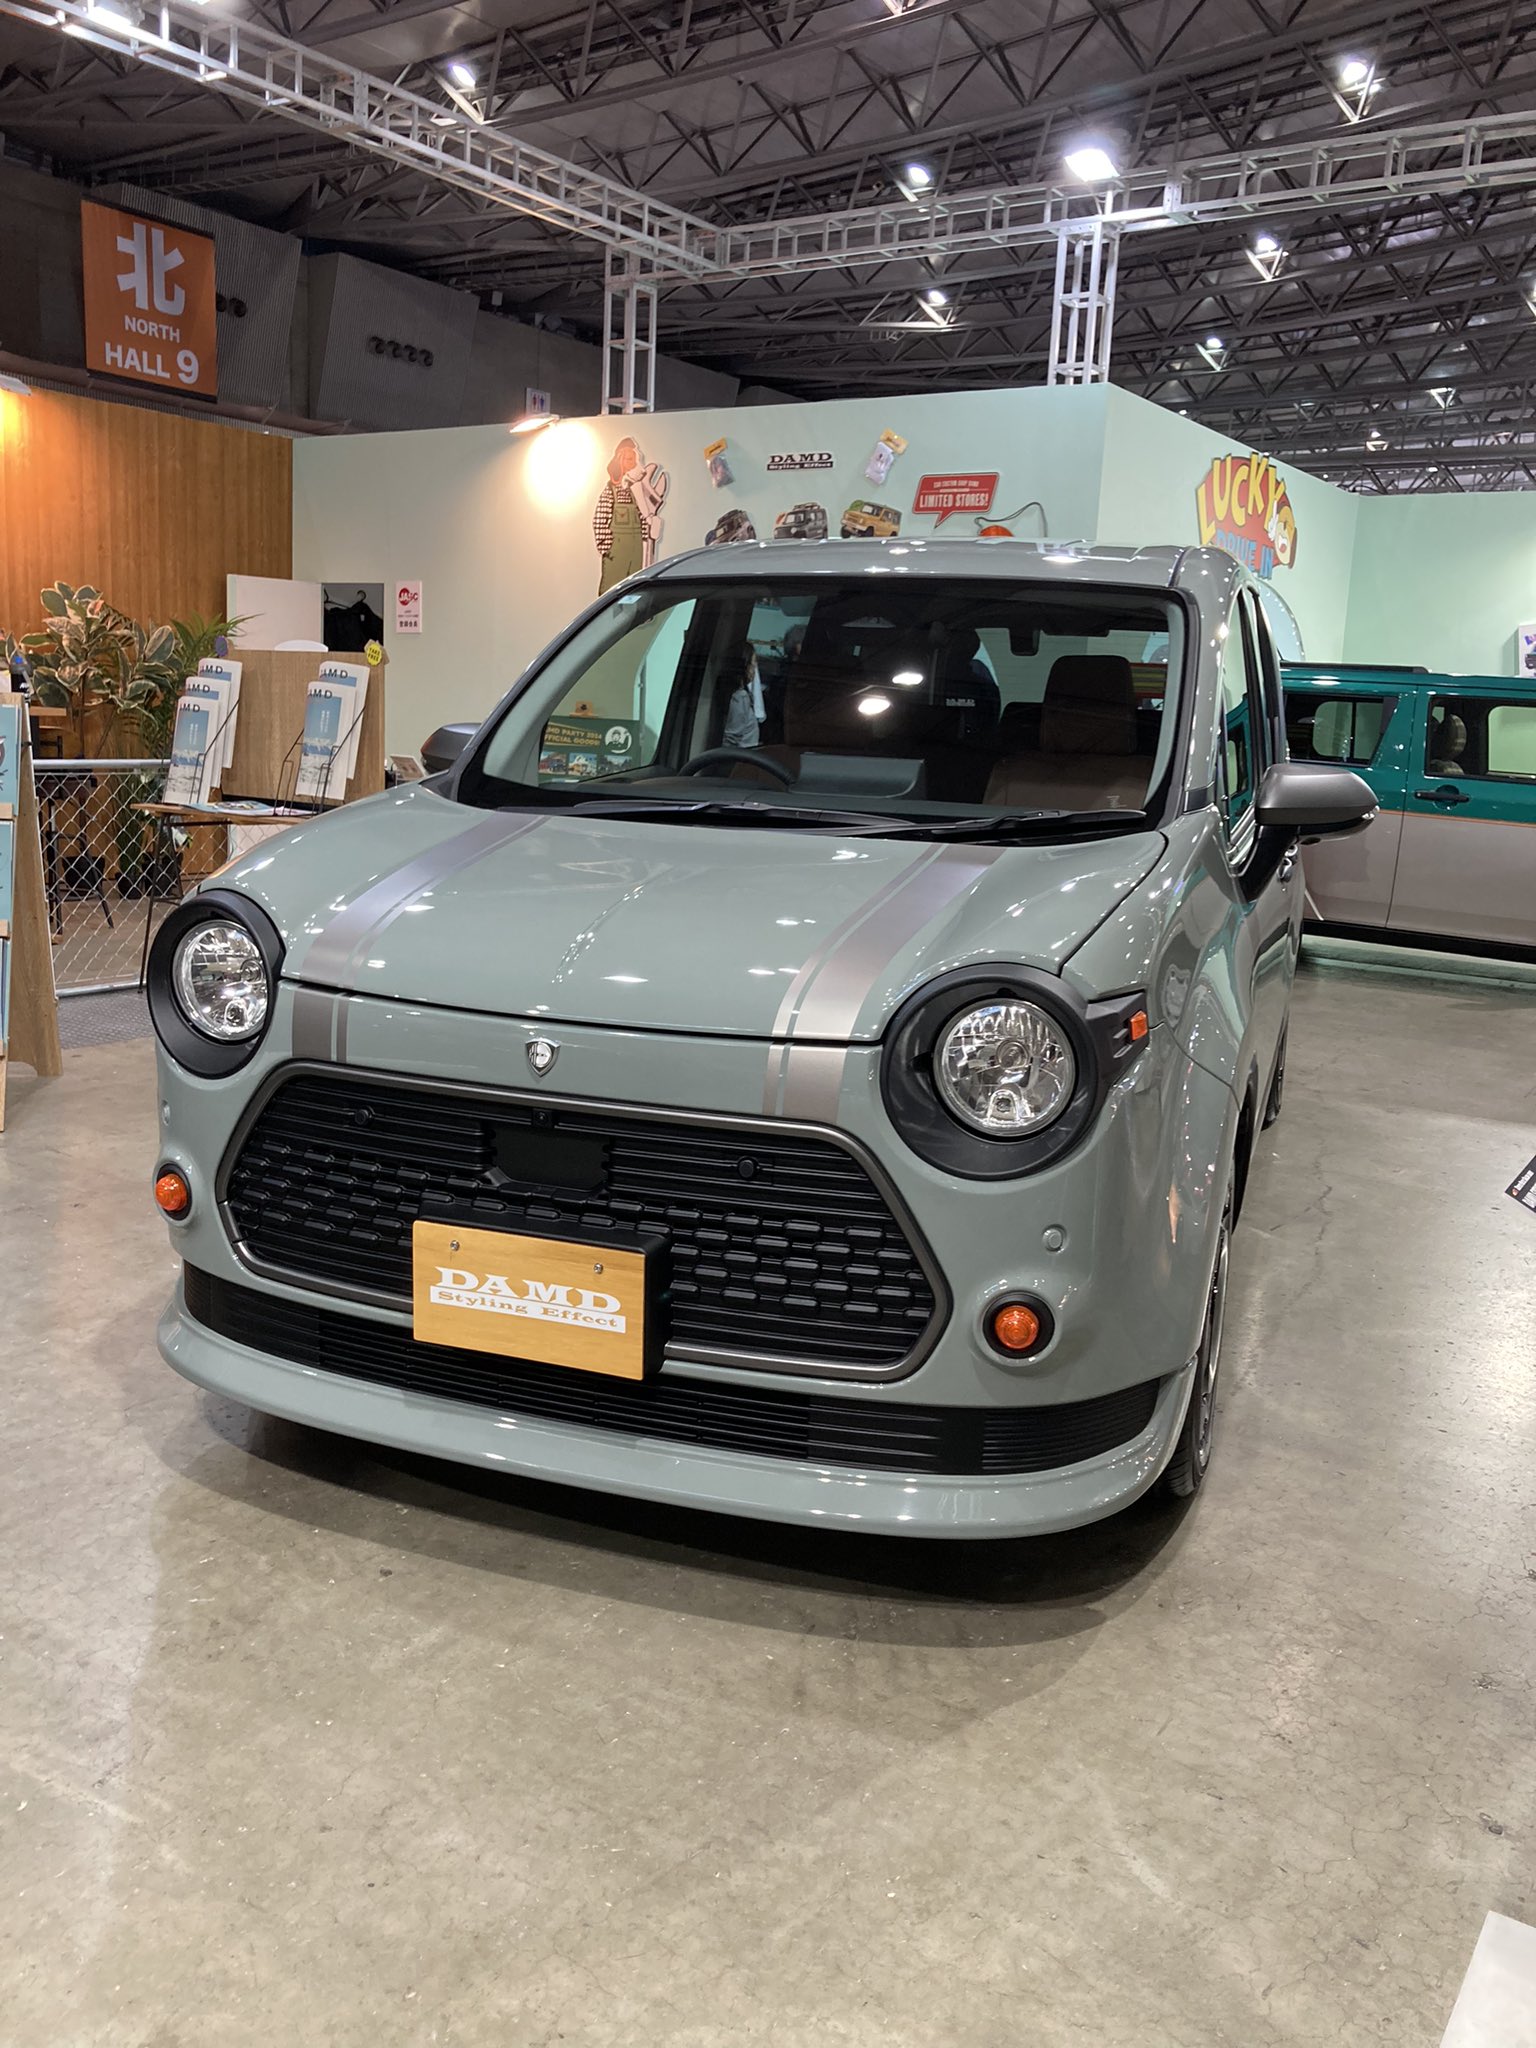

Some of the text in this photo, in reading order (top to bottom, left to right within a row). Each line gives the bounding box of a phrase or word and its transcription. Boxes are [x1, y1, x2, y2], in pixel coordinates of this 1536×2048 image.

[116, 222, 186, 316] 北
[124, 314, 181, 344] NORTH
[104, 341, 200, 385] HALL 9
[769, 452, 833, 463] DAMD
[919, 492, 989, 508] LIMITED STORES!
[1195, 452, 1286, 546] LUCKY
[367, 653, 380, 662] FREE
[368, 647, 381, 656] TAKE
[562, 729, 585, 737] PARTY
[435, 1266, 621, 1313] DAMD
[438, 1291, 618, 1328] Styling Effect
